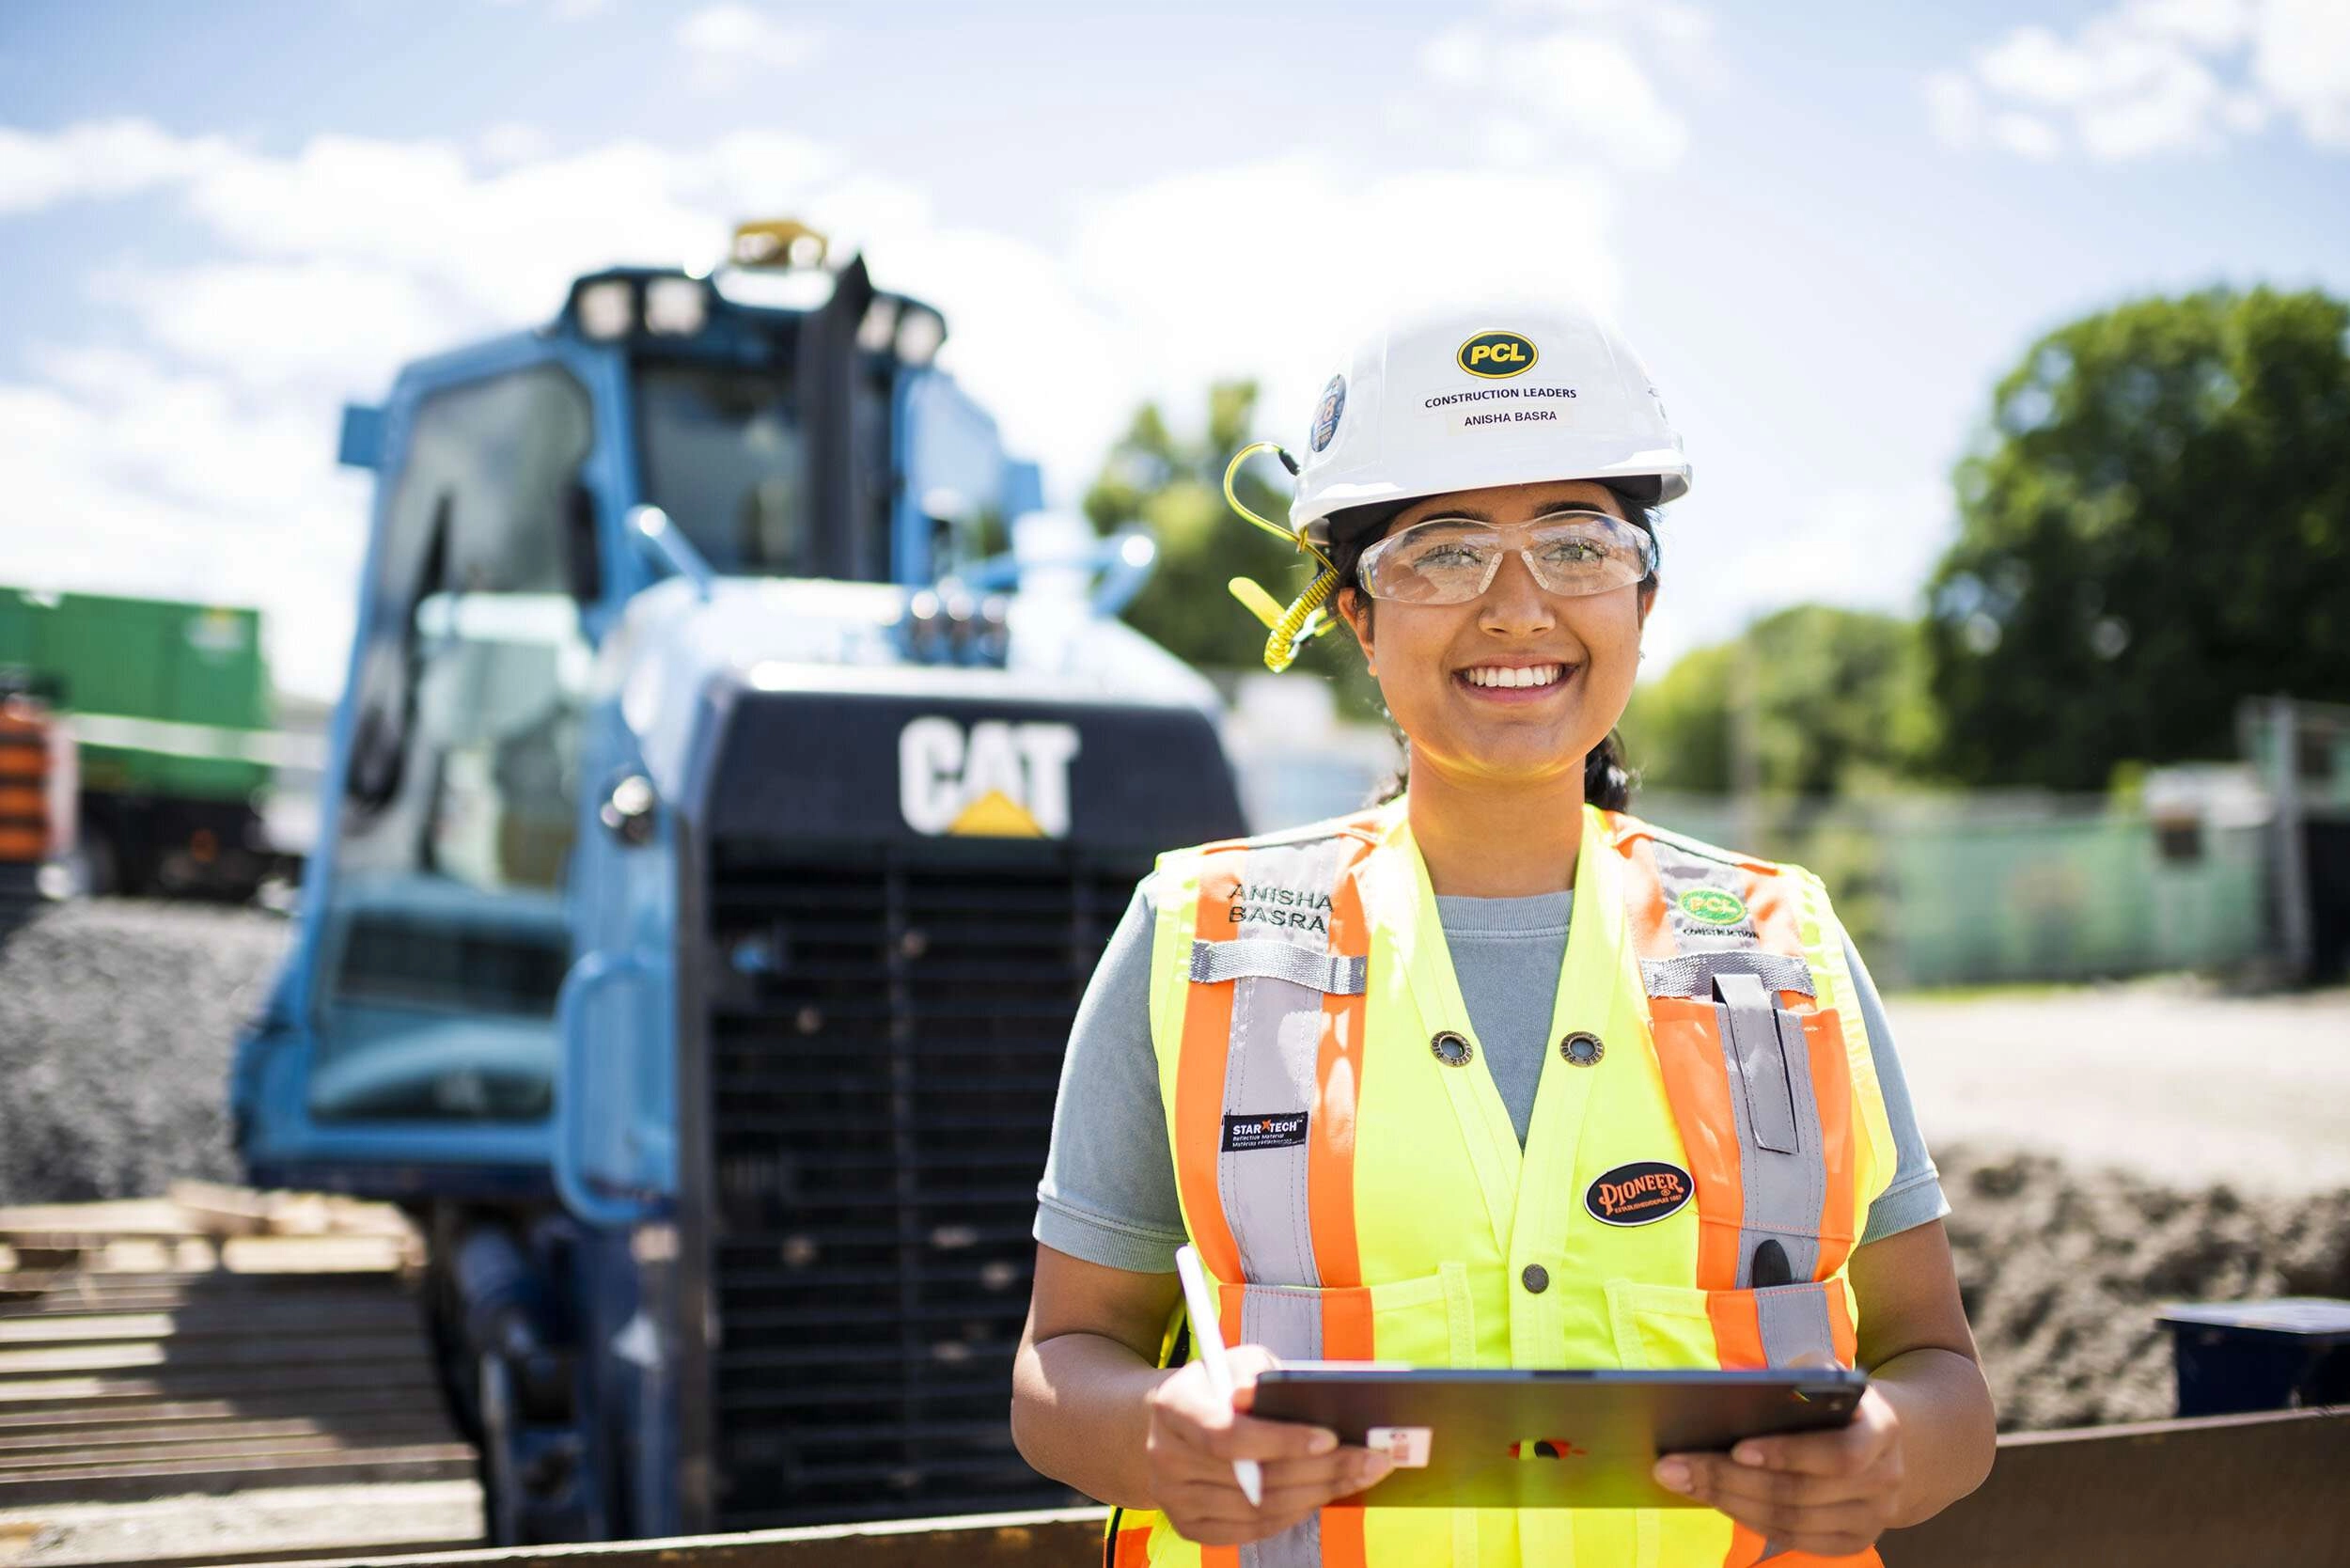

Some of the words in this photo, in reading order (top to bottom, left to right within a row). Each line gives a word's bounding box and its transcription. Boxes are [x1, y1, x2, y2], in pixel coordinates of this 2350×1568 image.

[1470, 342, 1526, 365] PCL
[1425, 388, 1519, 408] CONSTRUCTION
[1523, 388, 1577, 399] LEADERS
[1465, 413, 1512, 426] ANISHA
[1514, 411, 1558, 422] BASRA
[899, 716, 1080, 839] CAT
[1227, 884, 1334, 912] ANISHA
[1690, 896, 1737, 914] PCL
[1229, 906, 1327, 933] BASRA
[1683, 927, 1760, 939] CONSTRUCTION
[1232, 1123, 1261, 1136] STAR
[1598, 1173, 1684, 1216] PIONEER
